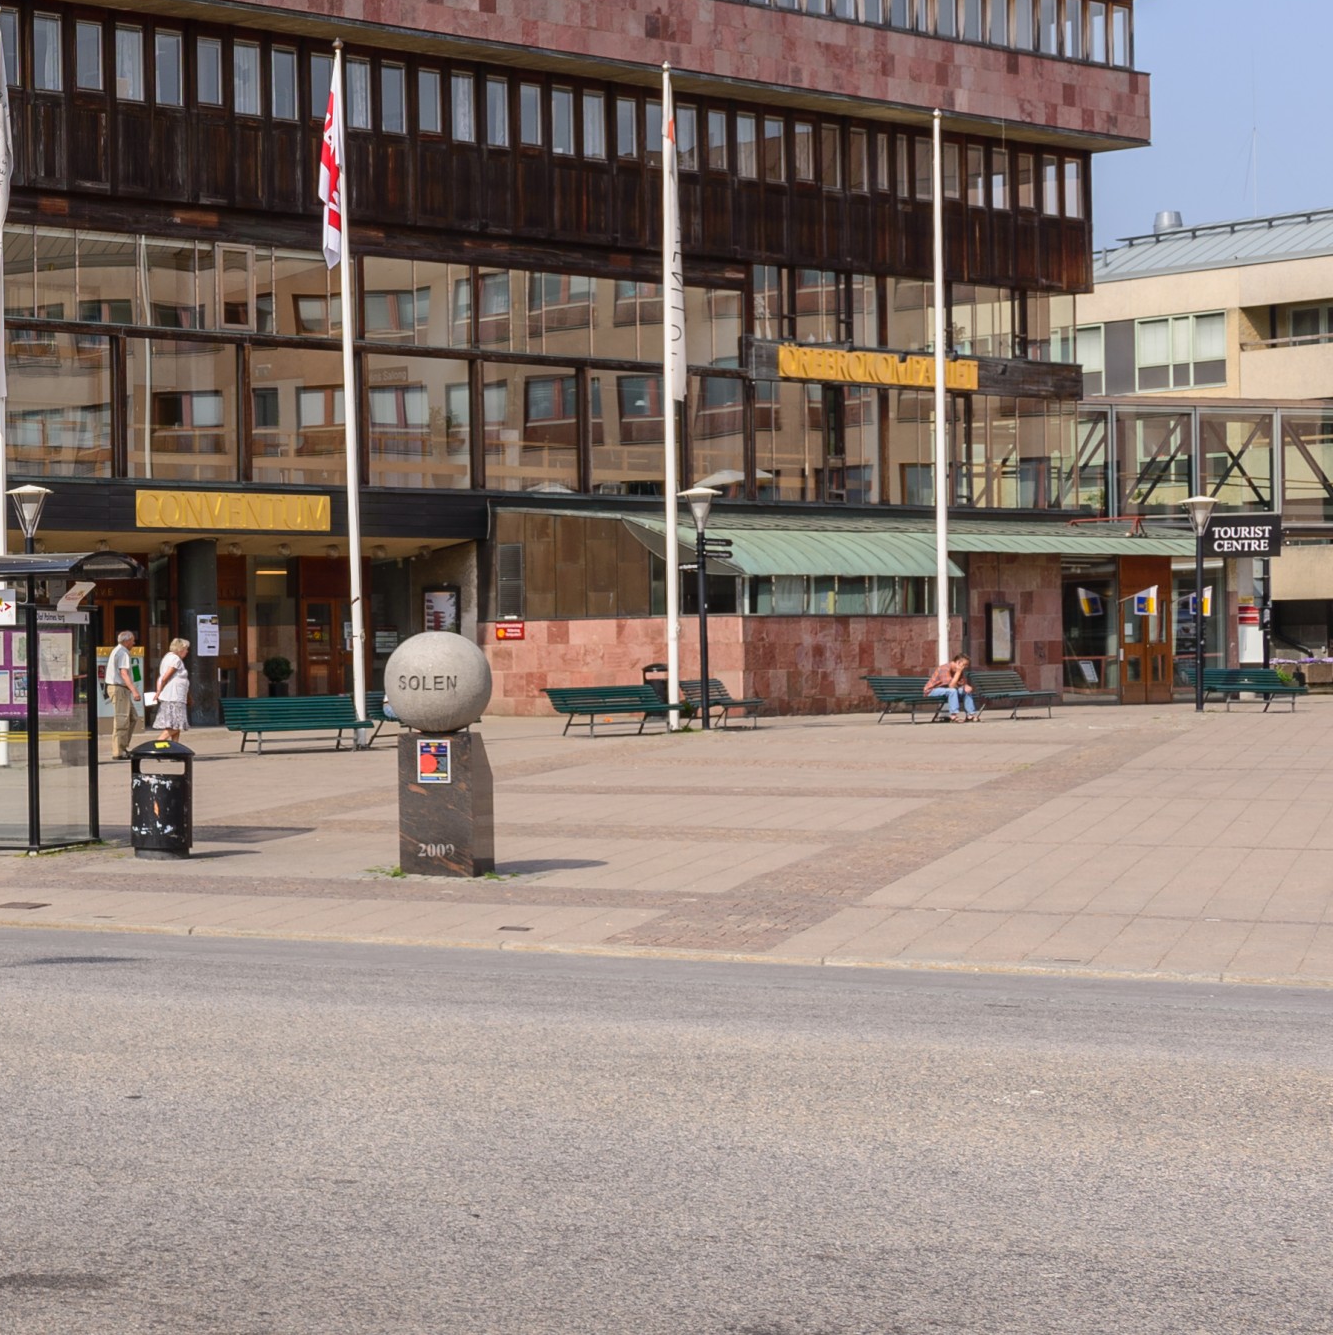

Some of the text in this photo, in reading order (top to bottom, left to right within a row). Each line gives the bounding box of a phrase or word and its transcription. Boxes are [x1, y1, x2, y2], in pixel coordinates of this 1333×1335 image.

[781, 342, 978, 388] ÖREBROKOMPAIET
[137, 493, 327, 529] CONVENTUM
[1212, 526, 1272, 539] TOURIST
[1213, 539, 1269, 552] CENTRE
[398, 674, 458, 692] SOLEN
[417, 843, 455, 858] 2009
